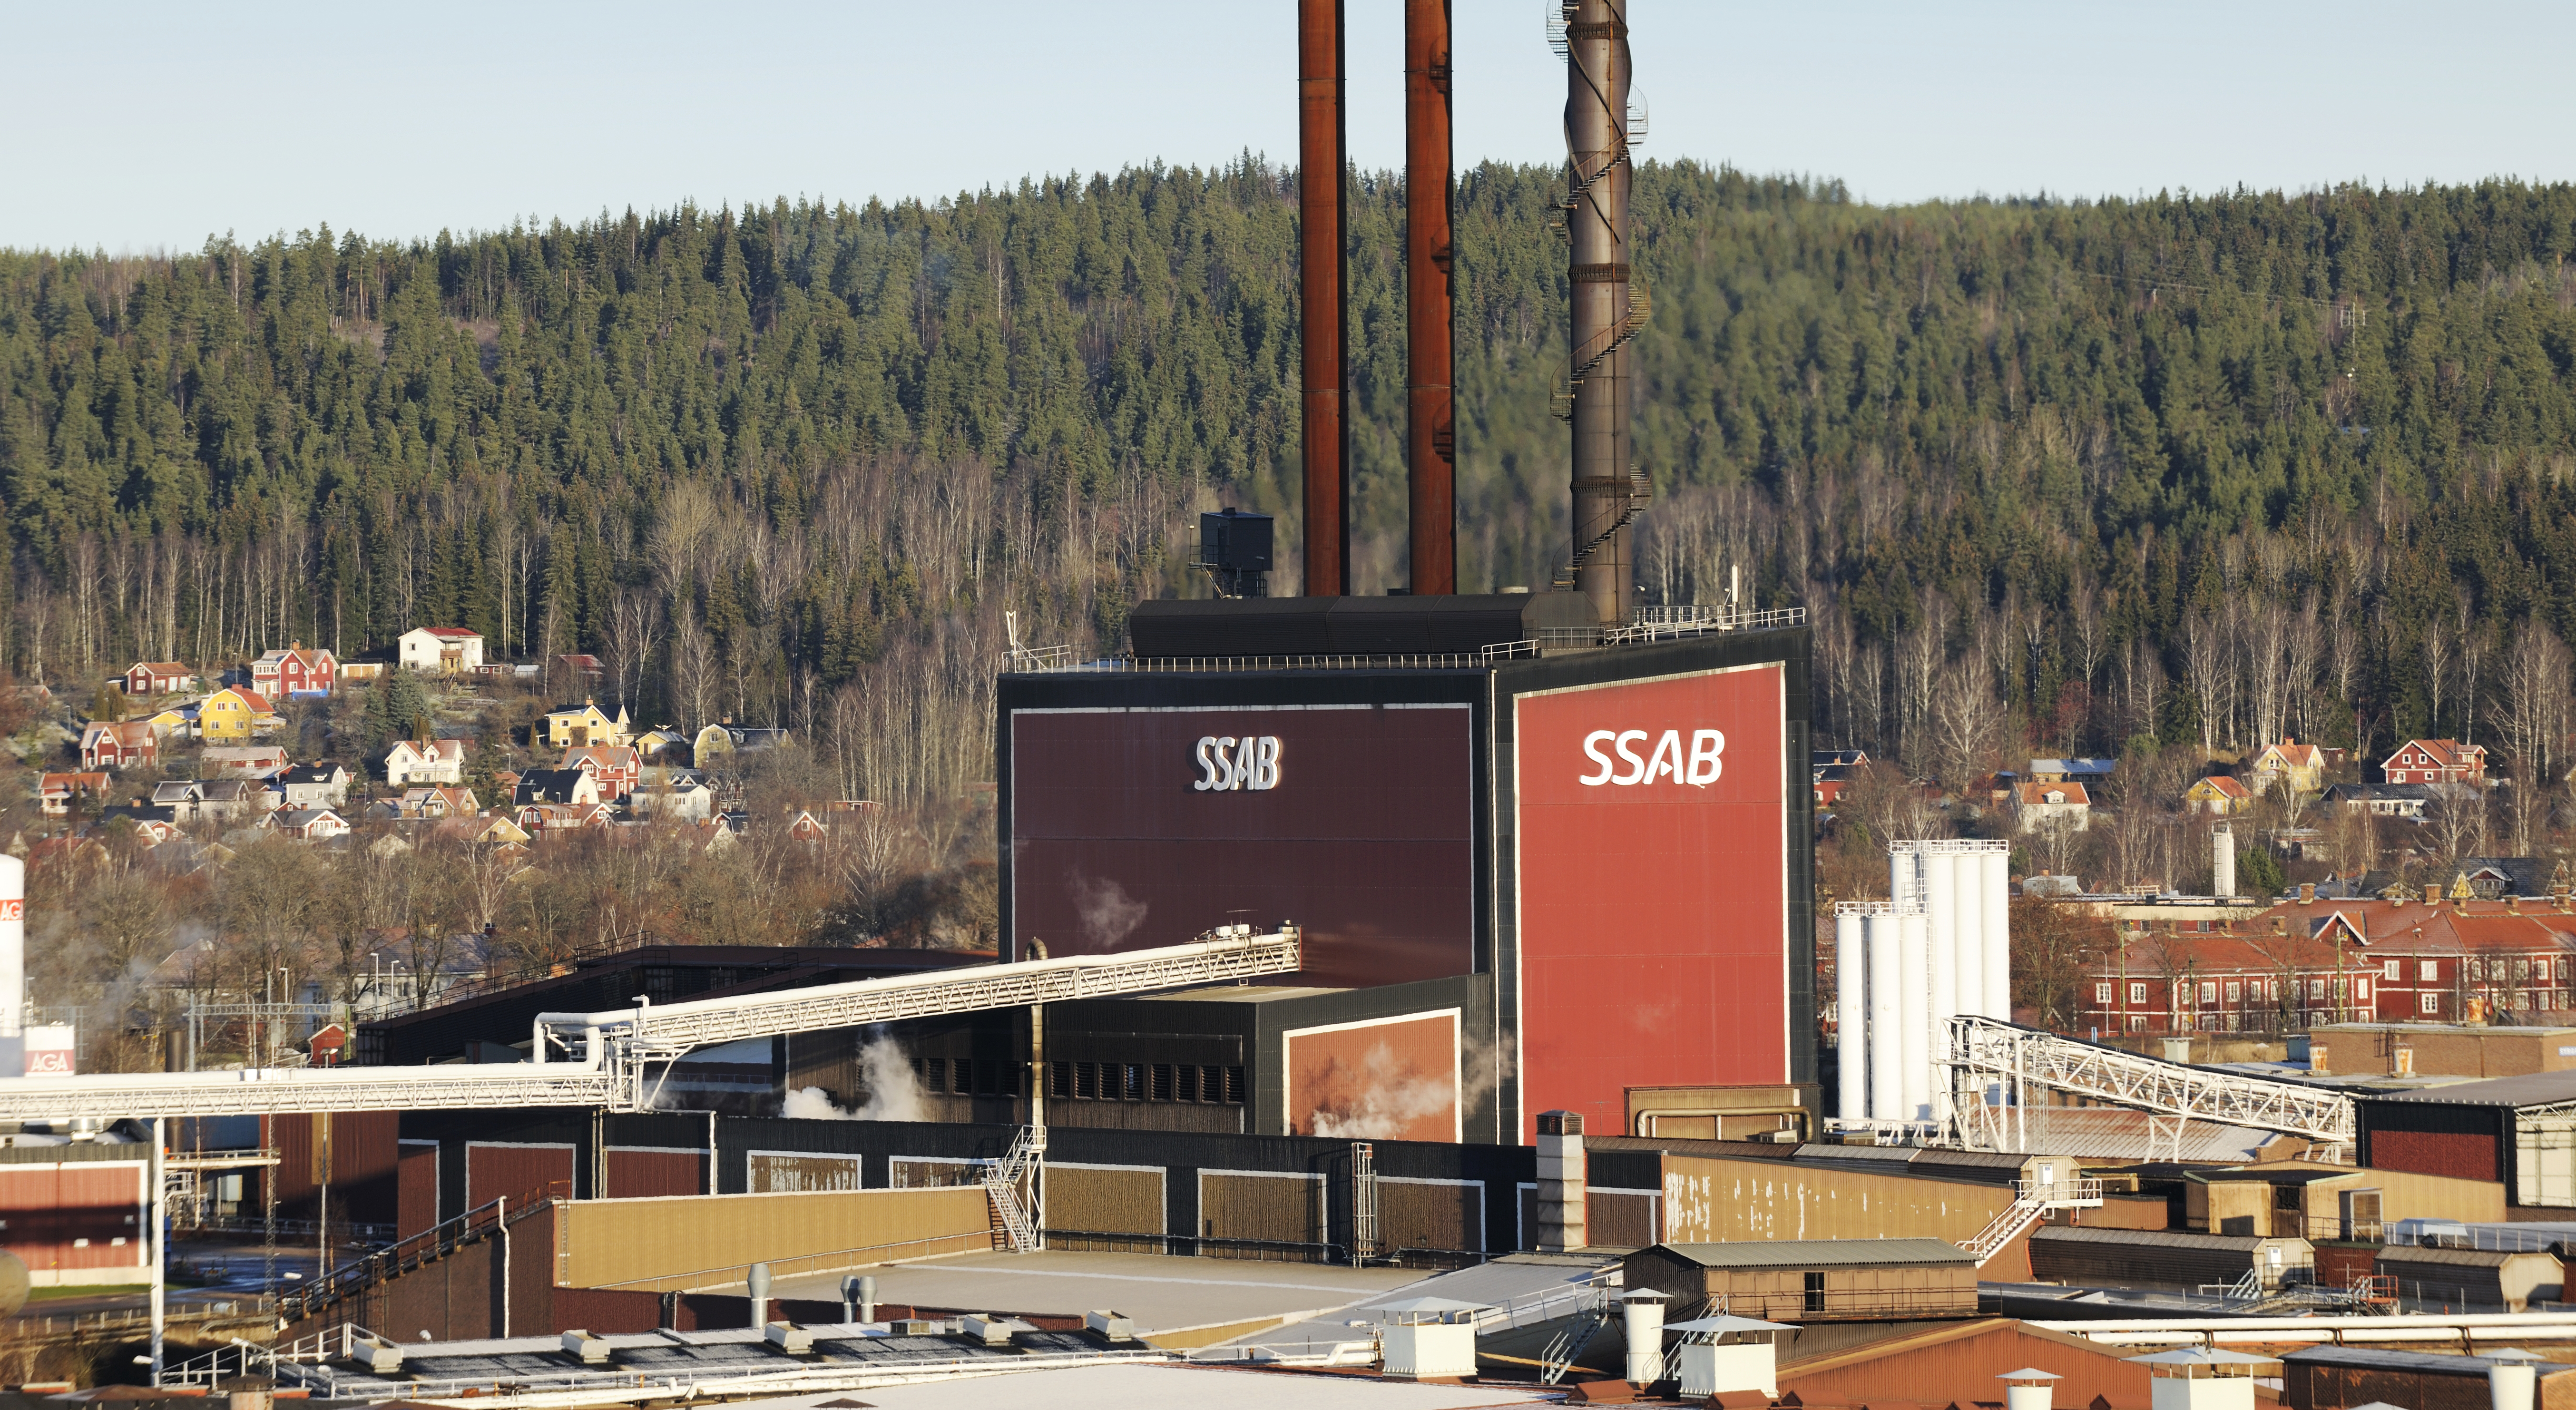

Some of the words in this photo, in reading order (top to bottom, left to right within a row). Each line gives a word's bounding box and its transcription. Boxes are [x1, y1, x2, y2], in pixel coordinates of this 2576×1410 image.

[1195, 736, 1280, 791] SSAB
[1579, 729, 1725, 786] SSAB
[30, 1051, 68, 1071] AGA
